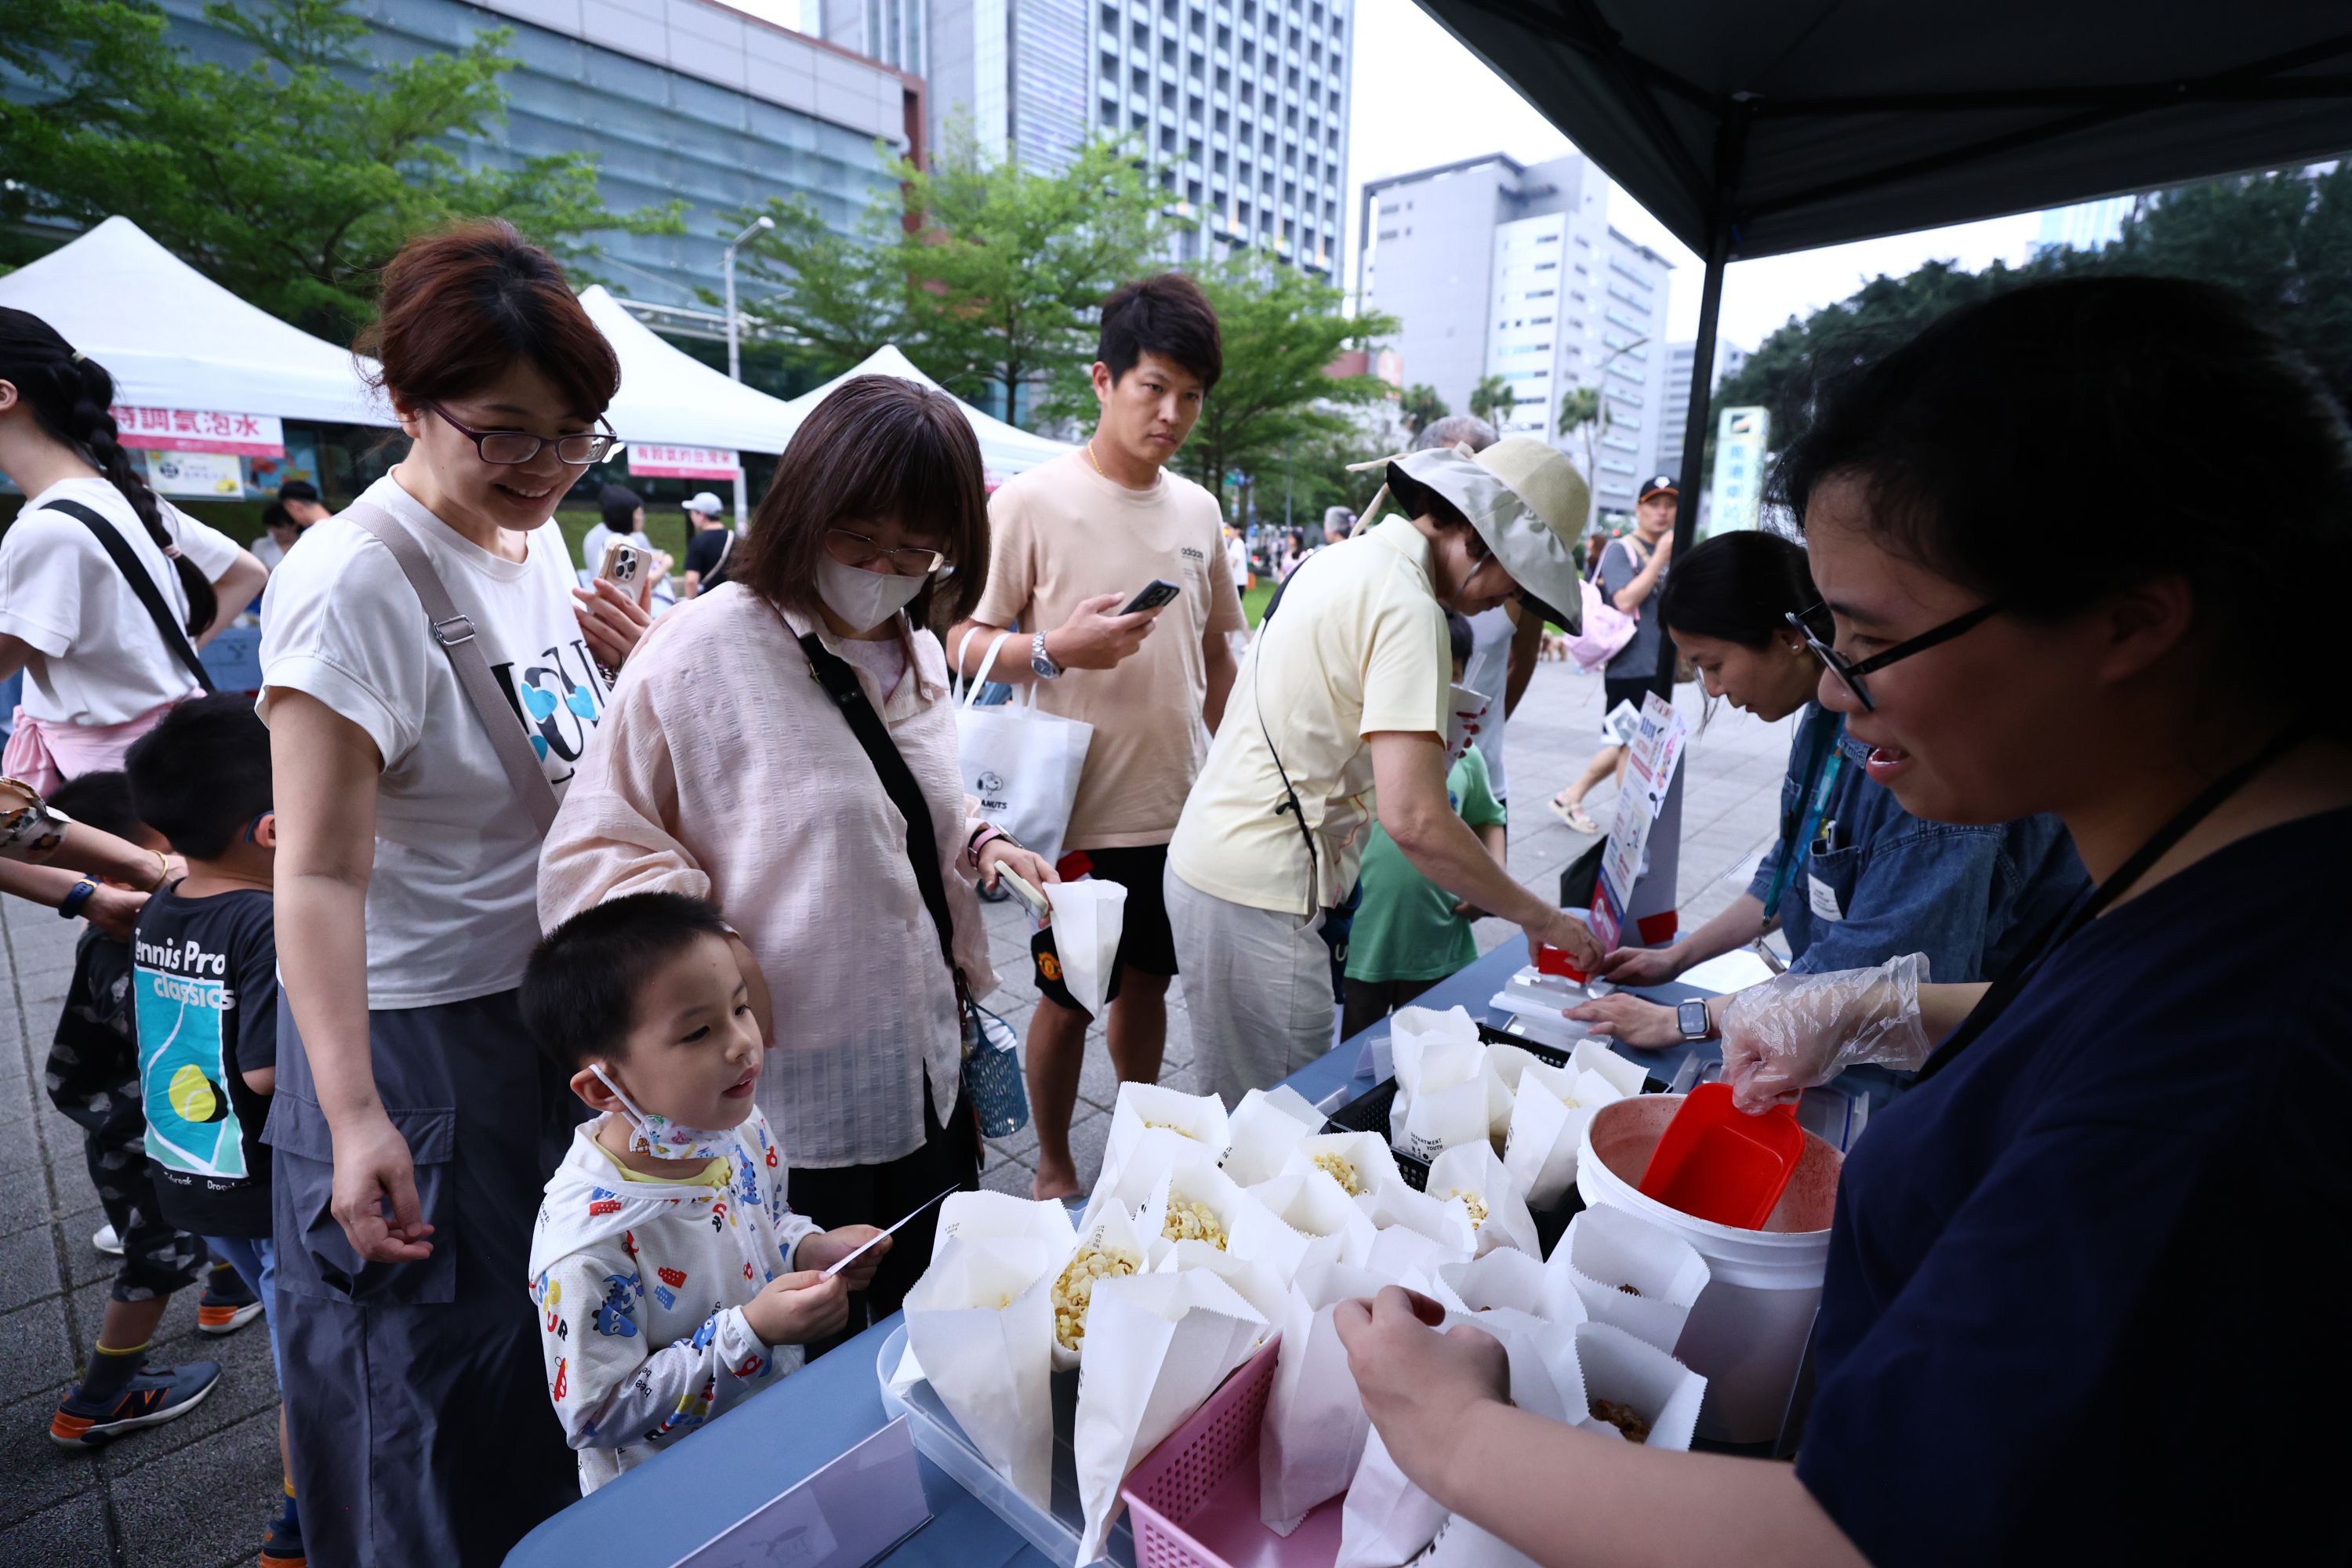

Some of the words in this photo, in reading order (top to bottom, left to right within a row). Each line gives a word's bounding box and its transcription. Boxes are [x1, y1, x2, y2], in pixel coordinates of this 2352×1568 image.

[981, 799, 1007, 809] ANUTS
[183, 940, 226, 975] Pro
[153, 968, 236, 1011] classics
